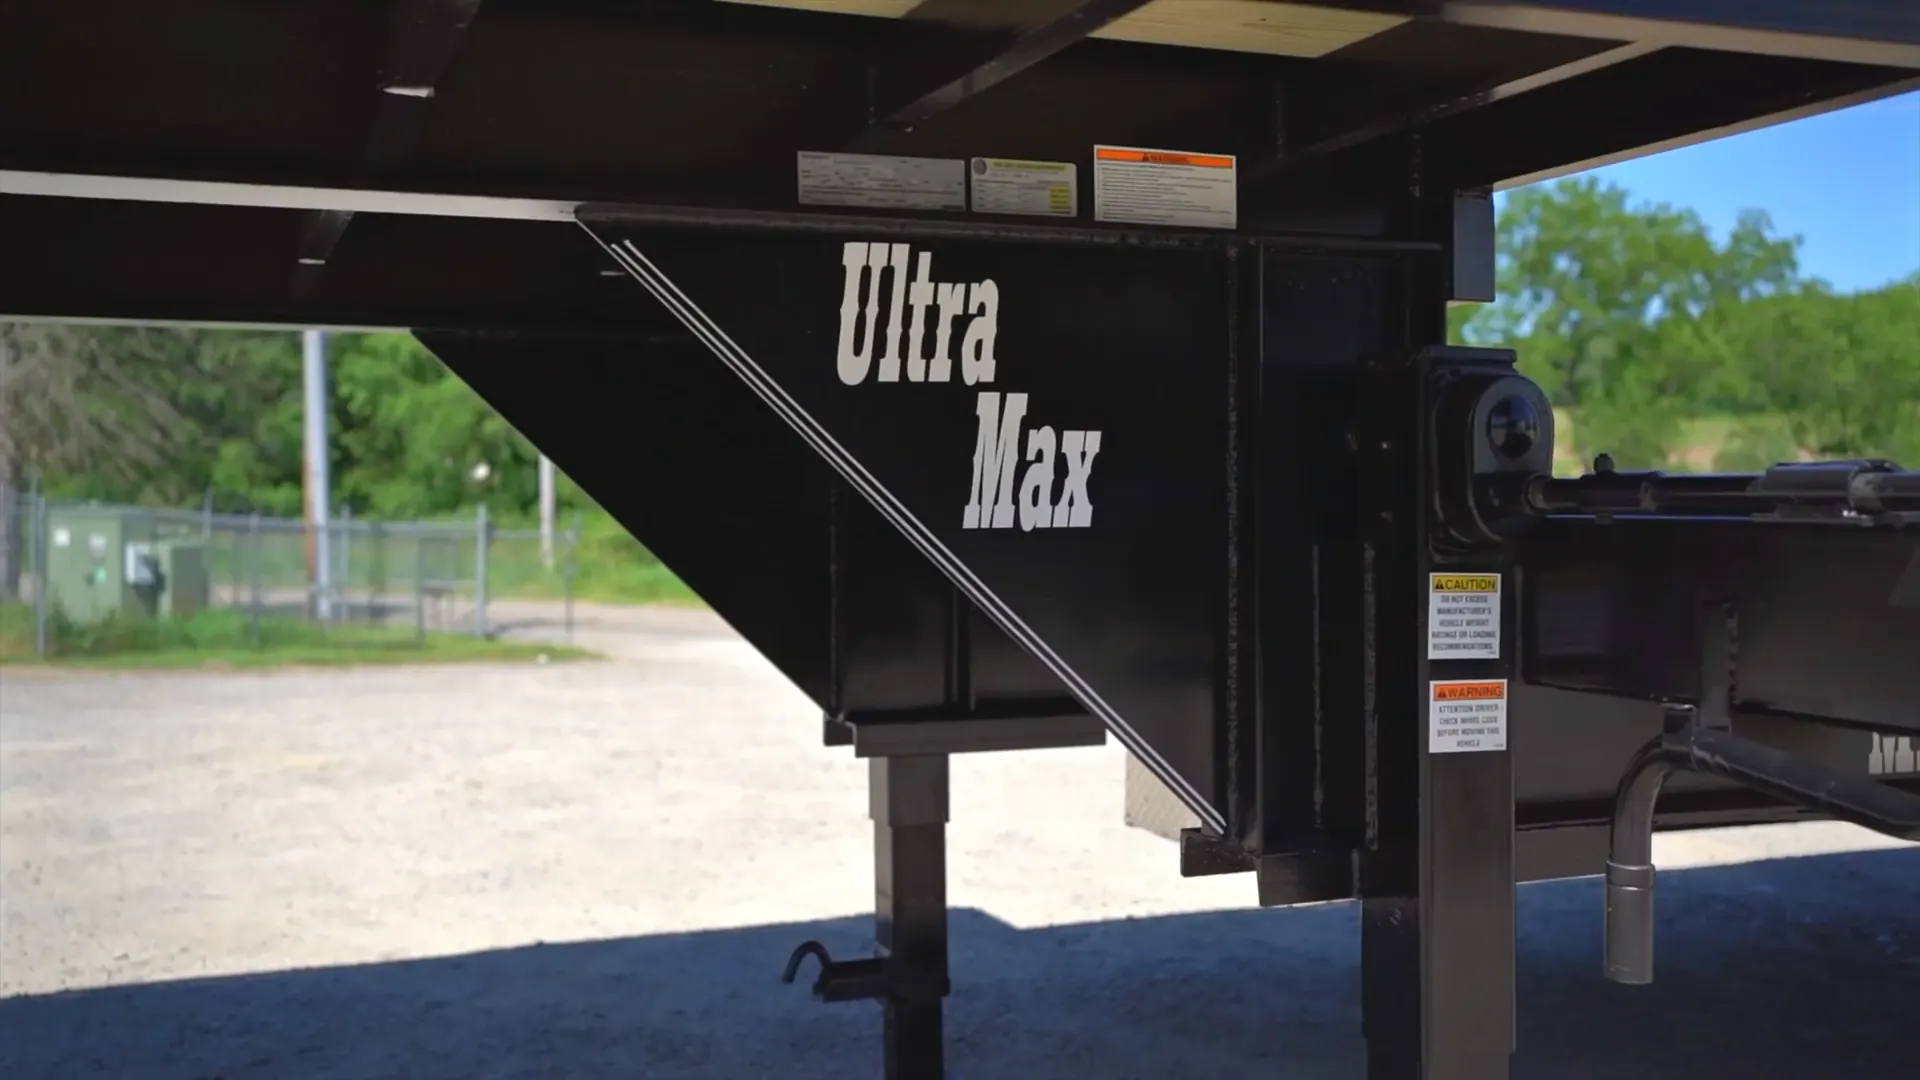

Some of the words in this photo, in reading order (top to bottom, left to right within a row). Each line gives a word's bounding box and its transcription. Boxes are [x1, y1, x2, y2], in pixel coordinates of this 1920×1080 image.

[836, 242, 999, 386] Ultra
[962, 391, 1102, 532] Max
[1444, 579, 1496, 590] CAUTION
[1447, 686, 1502, 698] WARNING
[1438, 705, 1473, 713] ATTENTION
[1456, 739, 1480, 747] VEHICLE
